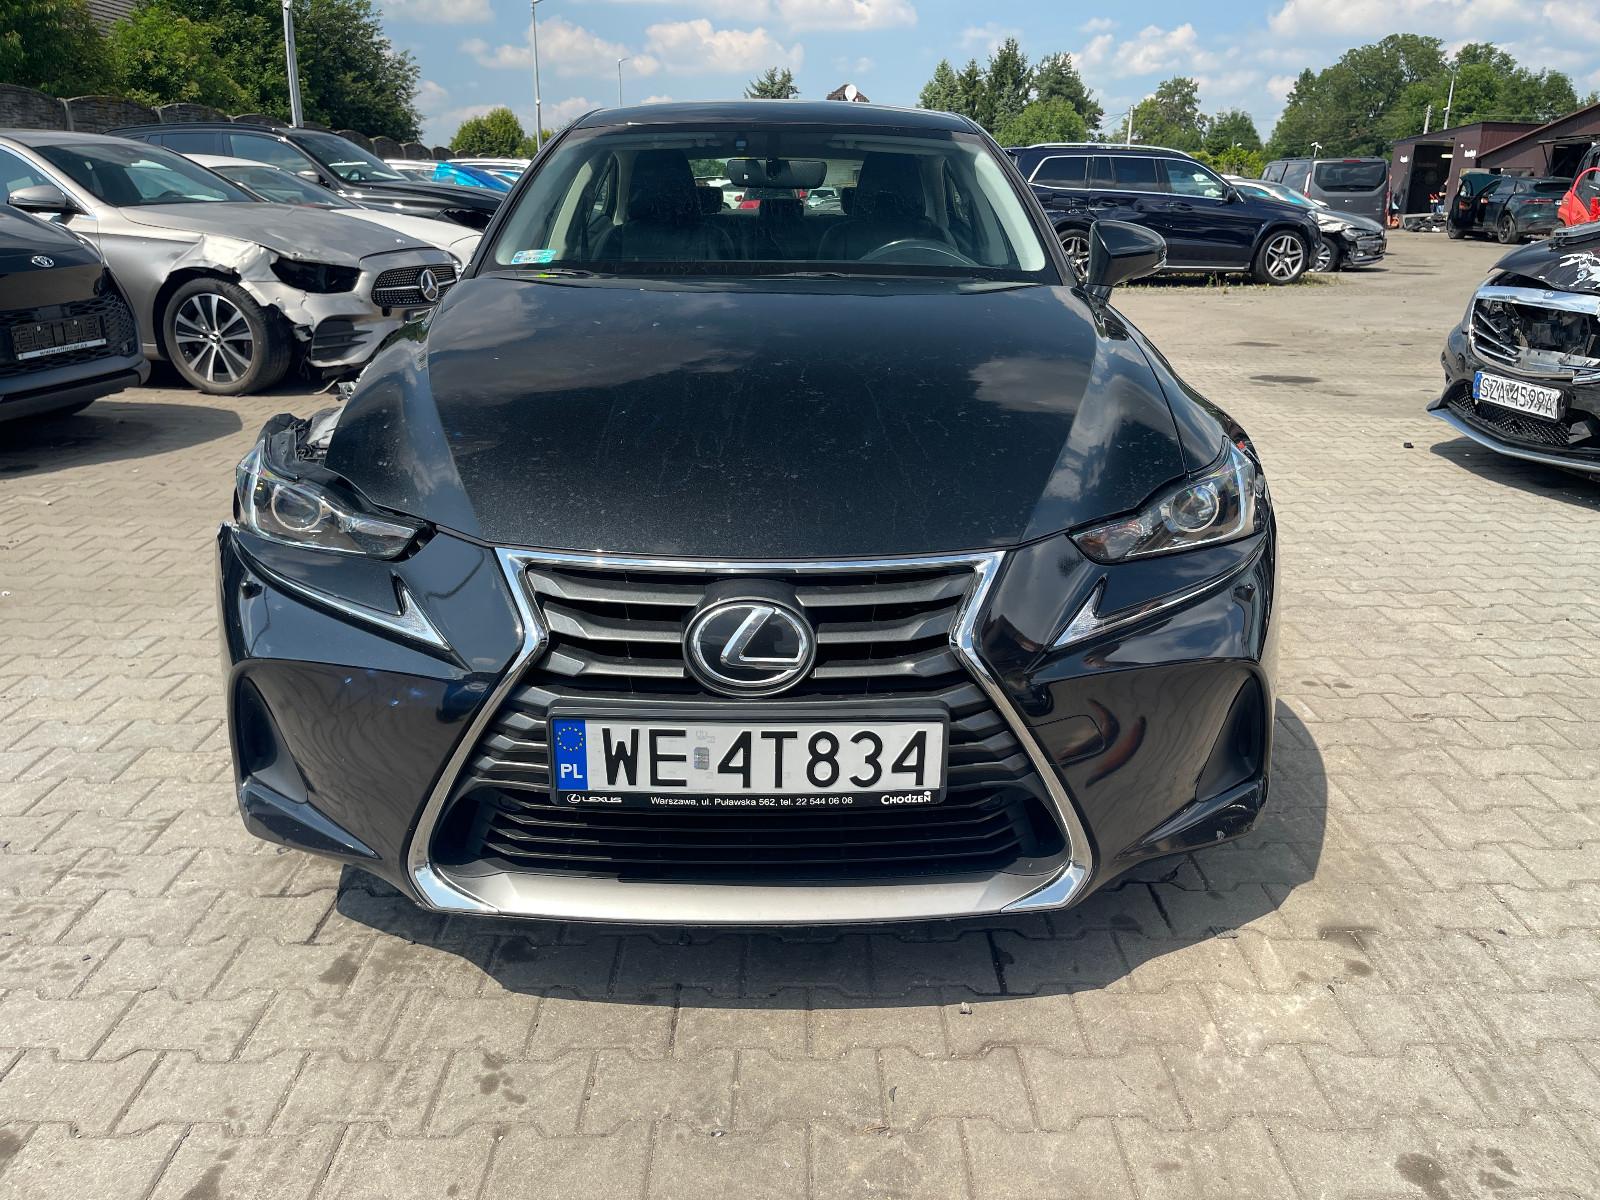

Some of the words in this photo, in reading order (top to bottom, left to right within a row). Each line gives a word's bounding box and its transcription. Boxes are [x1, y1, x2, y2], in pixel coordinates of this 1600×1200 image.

[1481, 378, 1506, 403] SZA
[601, 728, 687, 786] WE
[717, 730, 927, 788] 4T834
[560, 763, 583, 779] PL
[650, 796, 699, 807] Warszawa,
[701, 797, 712, 806] ul.
[714, 798, 756, 806] Puławska
[758, 798, 778, 807] 562,
[780, 798, 793, 806] tel.
[796, 798, 807, 806] 22
[828, 797, 840, 805] 06
